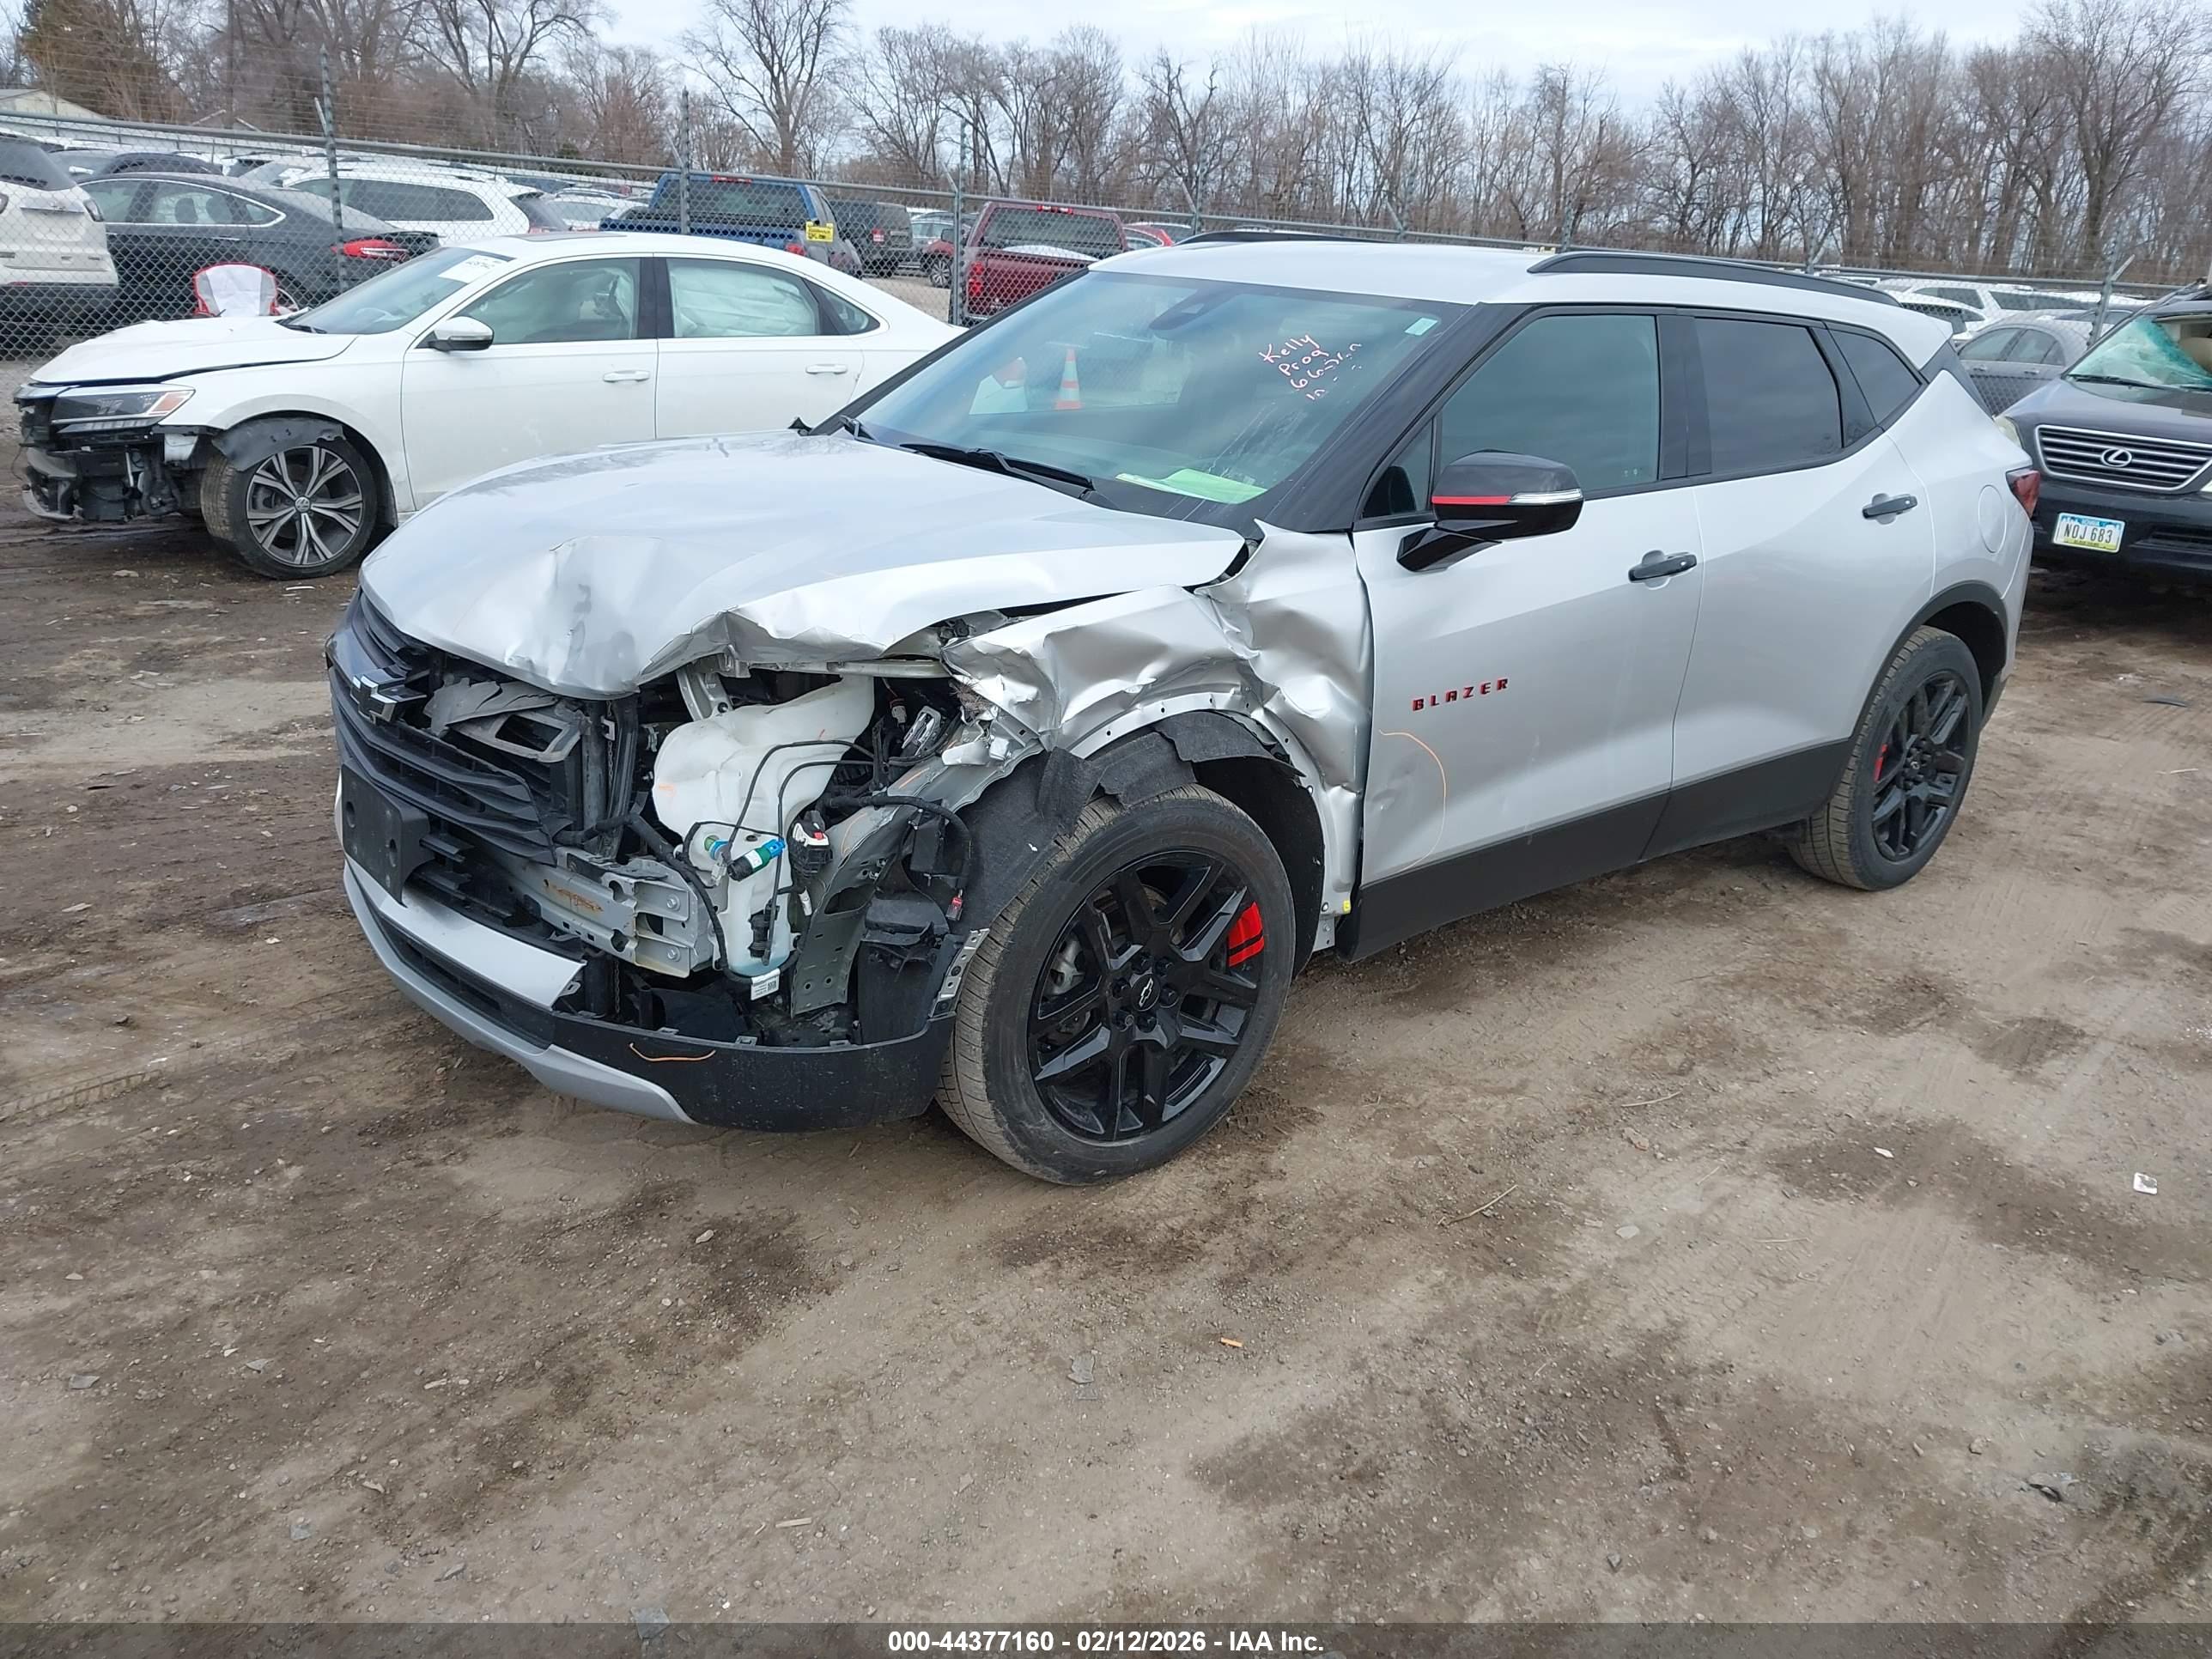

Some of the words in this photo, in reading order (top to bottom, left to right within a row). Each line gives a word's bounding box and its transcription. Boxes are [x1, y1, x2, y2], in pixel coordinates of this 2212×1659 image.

[1258, 334, 1321, 363] Kelly
[2090, 527, 2113, 544] 683
[1412, 678, 1509, 712] BLAZER
